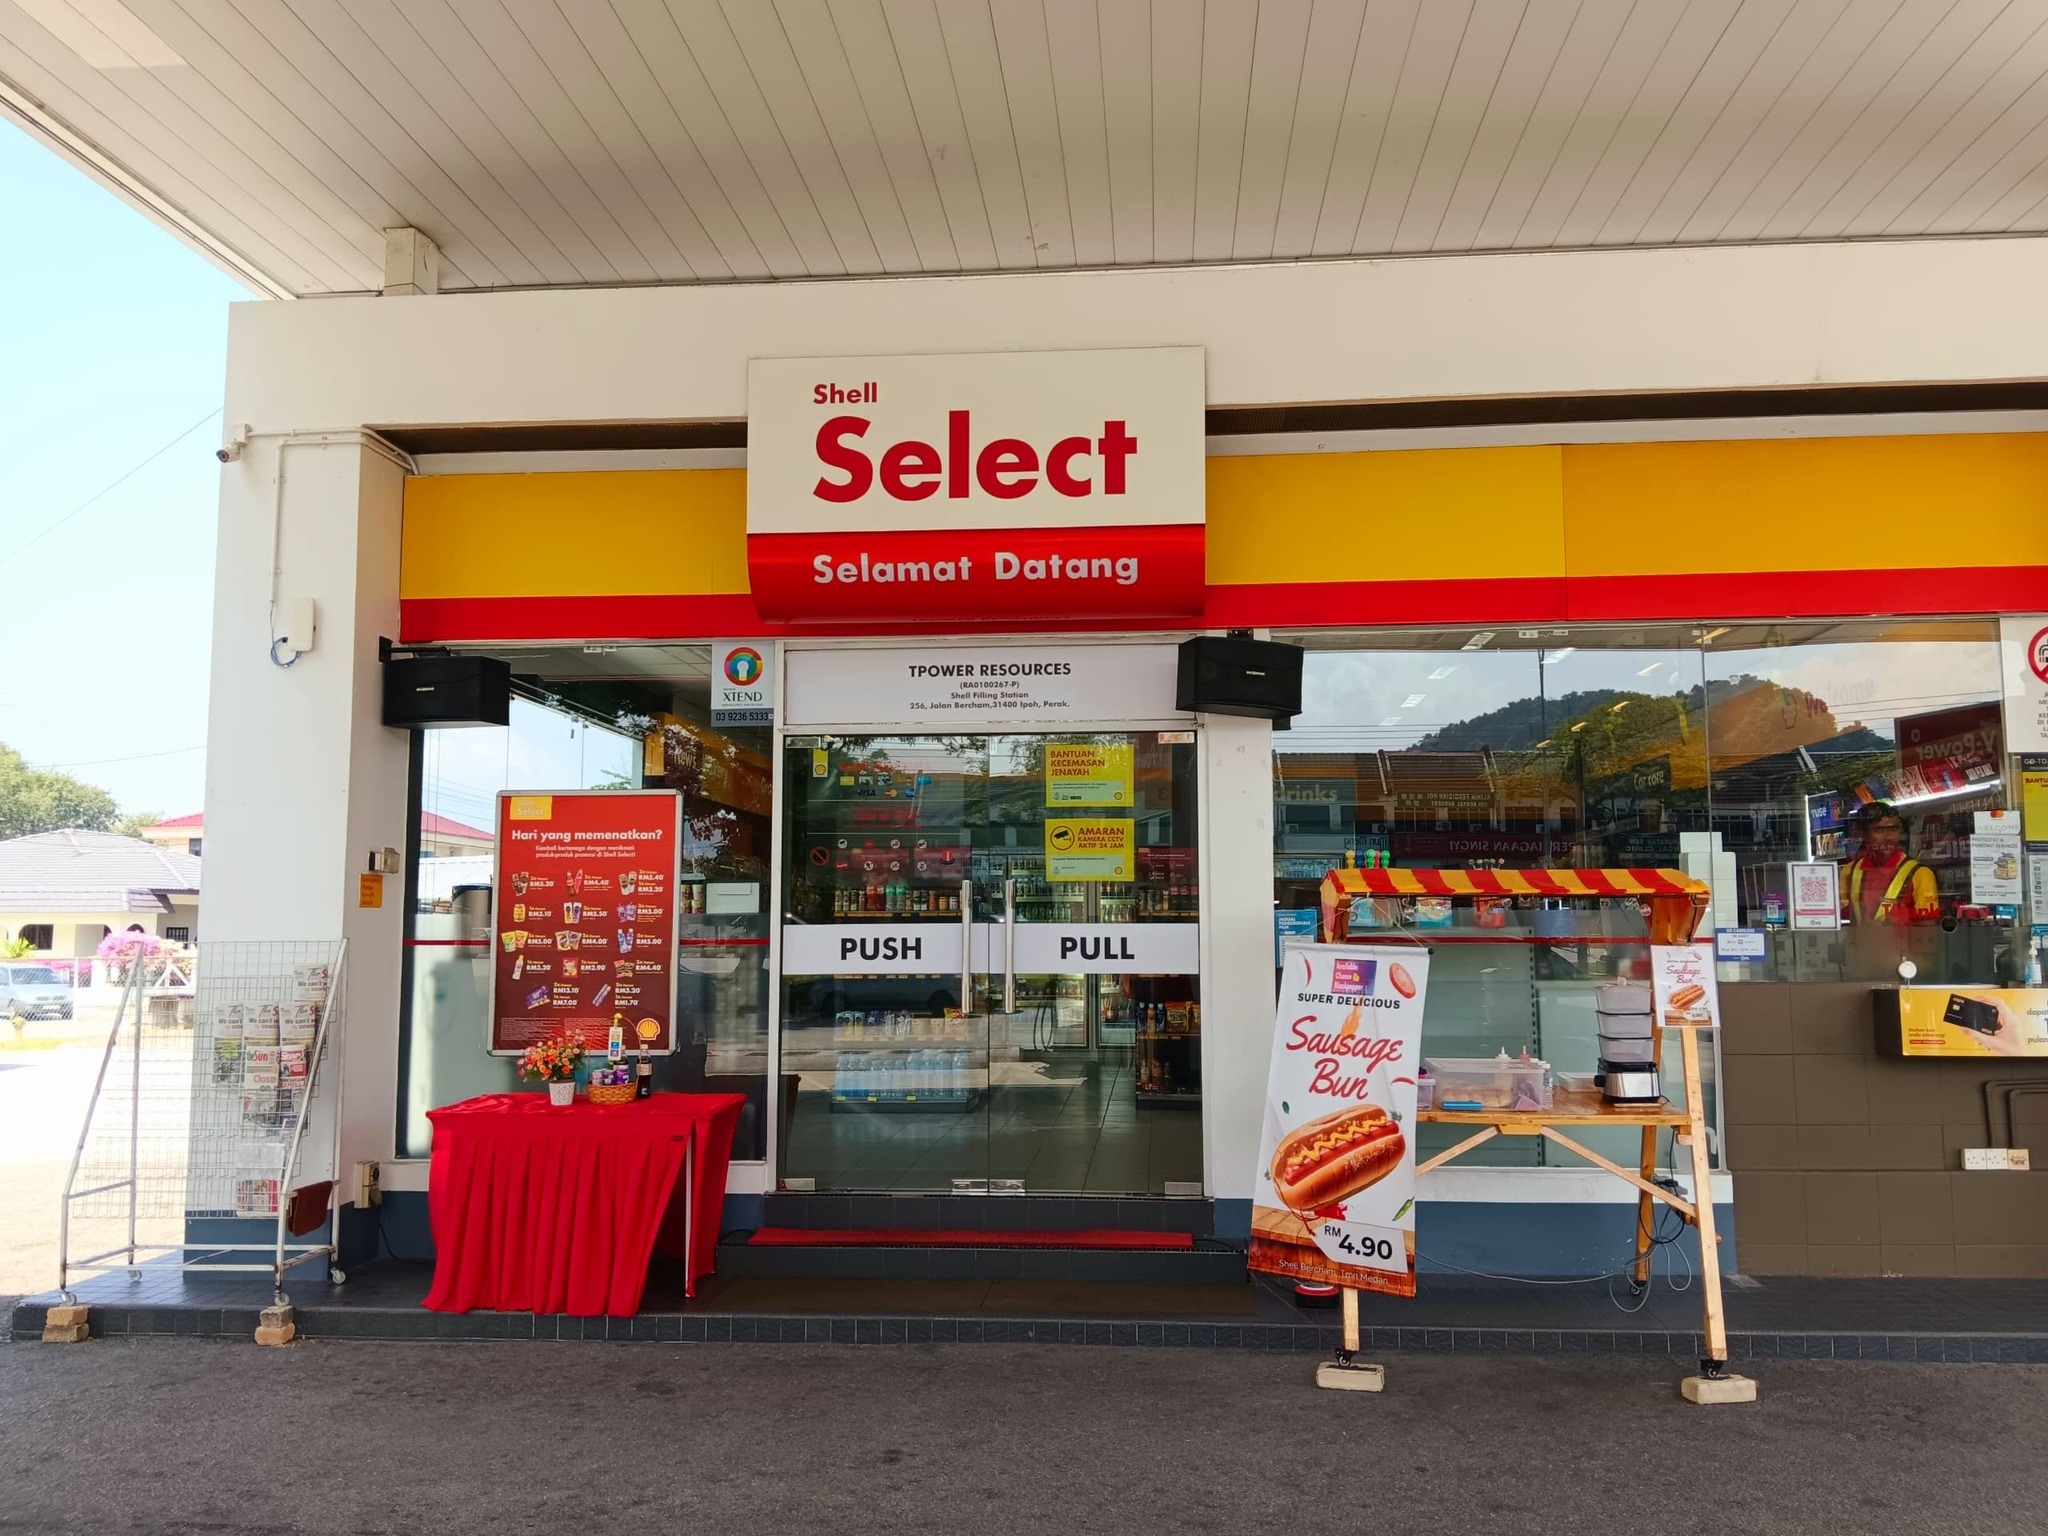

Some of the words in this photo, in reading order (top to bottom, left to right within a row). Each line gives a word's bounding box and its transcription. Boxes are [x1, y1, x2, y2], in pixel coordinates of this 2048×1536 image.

[813, 382, 877, 404] Shell
[813, 410, 1137, 503] Select
[813, 553, 971, 584] Selamat
[995, 552, 1138, 585] Datang
[909, 665, 974, 677] TPOWER
[980, 663, 1071, 676] RESOURCES
[960, 681, 1020, 689] (RA0100267-P)
[723, 692, 762, 702] XTEND
[973, 692, 998, 700] Filling
[1000, 691, 1029, 699] Station
[910, 702, 927, 710] 256,
[1020, 701, 1041, 709] Ipoh,
[716, 712, 725, 721] 03
[728, 712, 747, 721] 9236
[750, 712, 769, 721] 5333
[1050, 750, 1095, 758] BANTUAN
[1050, 768, 1090, 776] JENAYAH
[1274, 784, 1338, 801] drinks
[512, 829, 537, 839] Hari
[540, 832, 571, 842] yang
[574, 829, 662, 840] memenatkan?
[841, 937, 921, 960] PUSH
[1061, 937, 1135, 960] PULL
[1666, 965, 1701, 977] Sausage
[1676, 975, 1692, 984] Bun
[1298, 993, 1333, 1004] SUPER
[1337, 996, 1400, 1009] DELICIOUS
[1286, 1015, 1403, 1073] Sausage
[253, 1075, 276, 1084] Close
[1309, 1058, 1368, 1100] Bun
[1325, 1225, 1341, 1237] RM
[1338, 1234, 1392, 1259] 4.90
[1280, 1260, 1298, 1270] Shell
[1360, 1273, 1388, 1284] Medan
